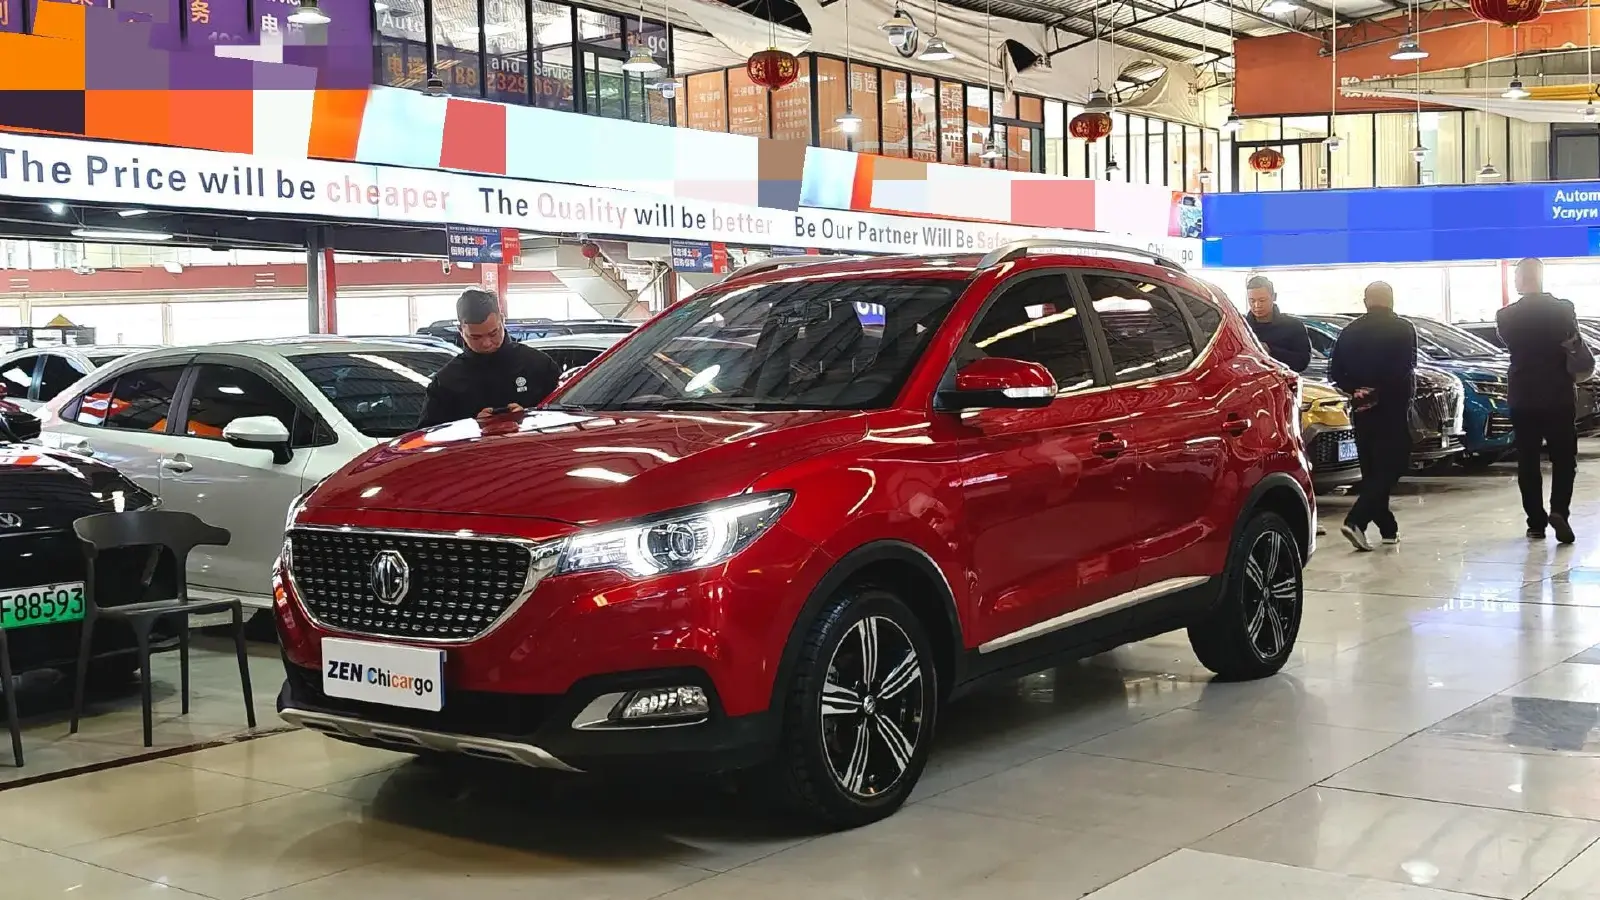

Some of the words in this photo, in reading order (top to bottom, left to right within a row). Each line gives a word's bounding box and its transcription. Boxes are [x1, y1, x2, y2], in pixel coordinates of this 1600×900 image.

[491, 57, 520, 73] and
[534, 60, 573, 80] Service
[0, 147, 72, 184] The
[87, 155, 187, 192] Price
[198, 166, 265, 197] will
[277, 169, 316, 201] be
[326, 175, 450, 213] cheaper
[478, 187, 529, 217] The
[537, 192, 627, 229] Quality
[634, 203, 674, 228] will
[682, 206, 706, 229] be
[712, 208, 773, 235] better
[795, 215, 816, 238] Be
[822, 218, 853, 239] Our
[858, 221, 918, 246] Partner
[922, 226, 952, 248] Will
[956, 229, 974, 249] Be
[0, 587, 84, 623] F88593
[327, 660, 363, 683] ZEN
[367, 667, 434, 696] Chicargo
